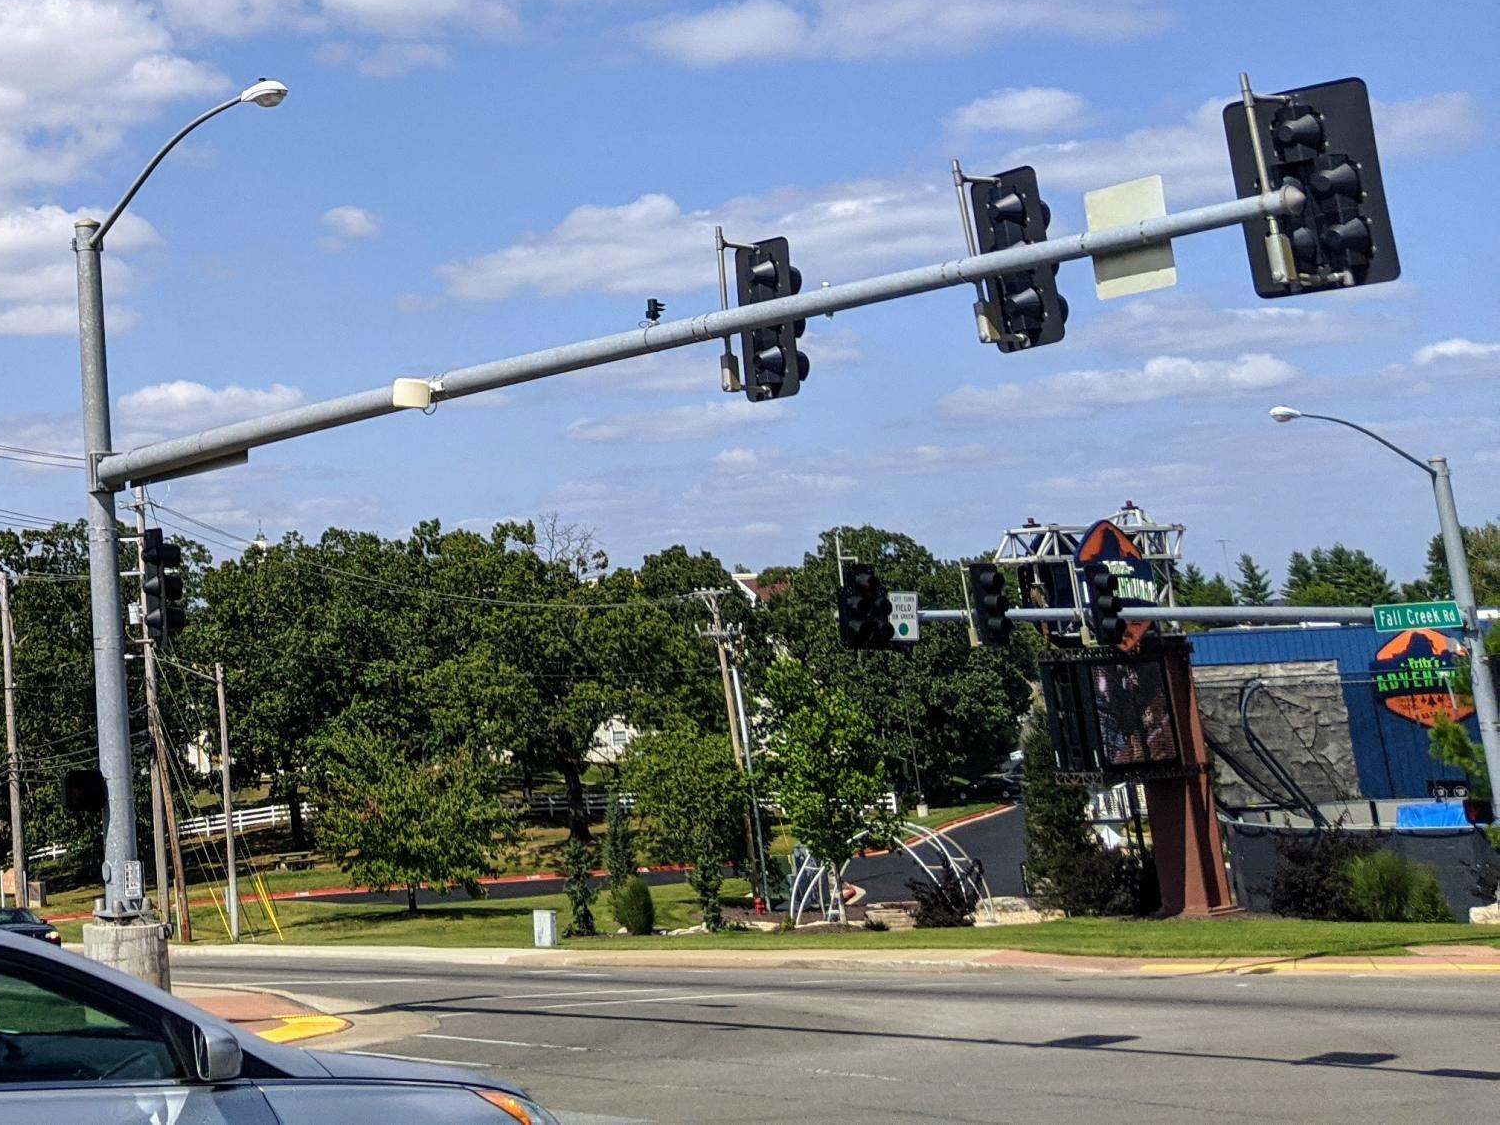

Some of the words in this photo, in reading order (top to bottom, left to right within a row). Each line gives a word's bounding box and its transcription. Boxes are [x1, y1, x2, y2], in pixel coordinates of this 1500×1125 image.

[895, 604, 912, 612] YIELD
[1379, 609, 1402, 627] Fall
[1406, 608, 1441, 625] Creek
[1443, 609, 1456, 622] Rd
[1408, 656, 1439, 669] Fritz's
